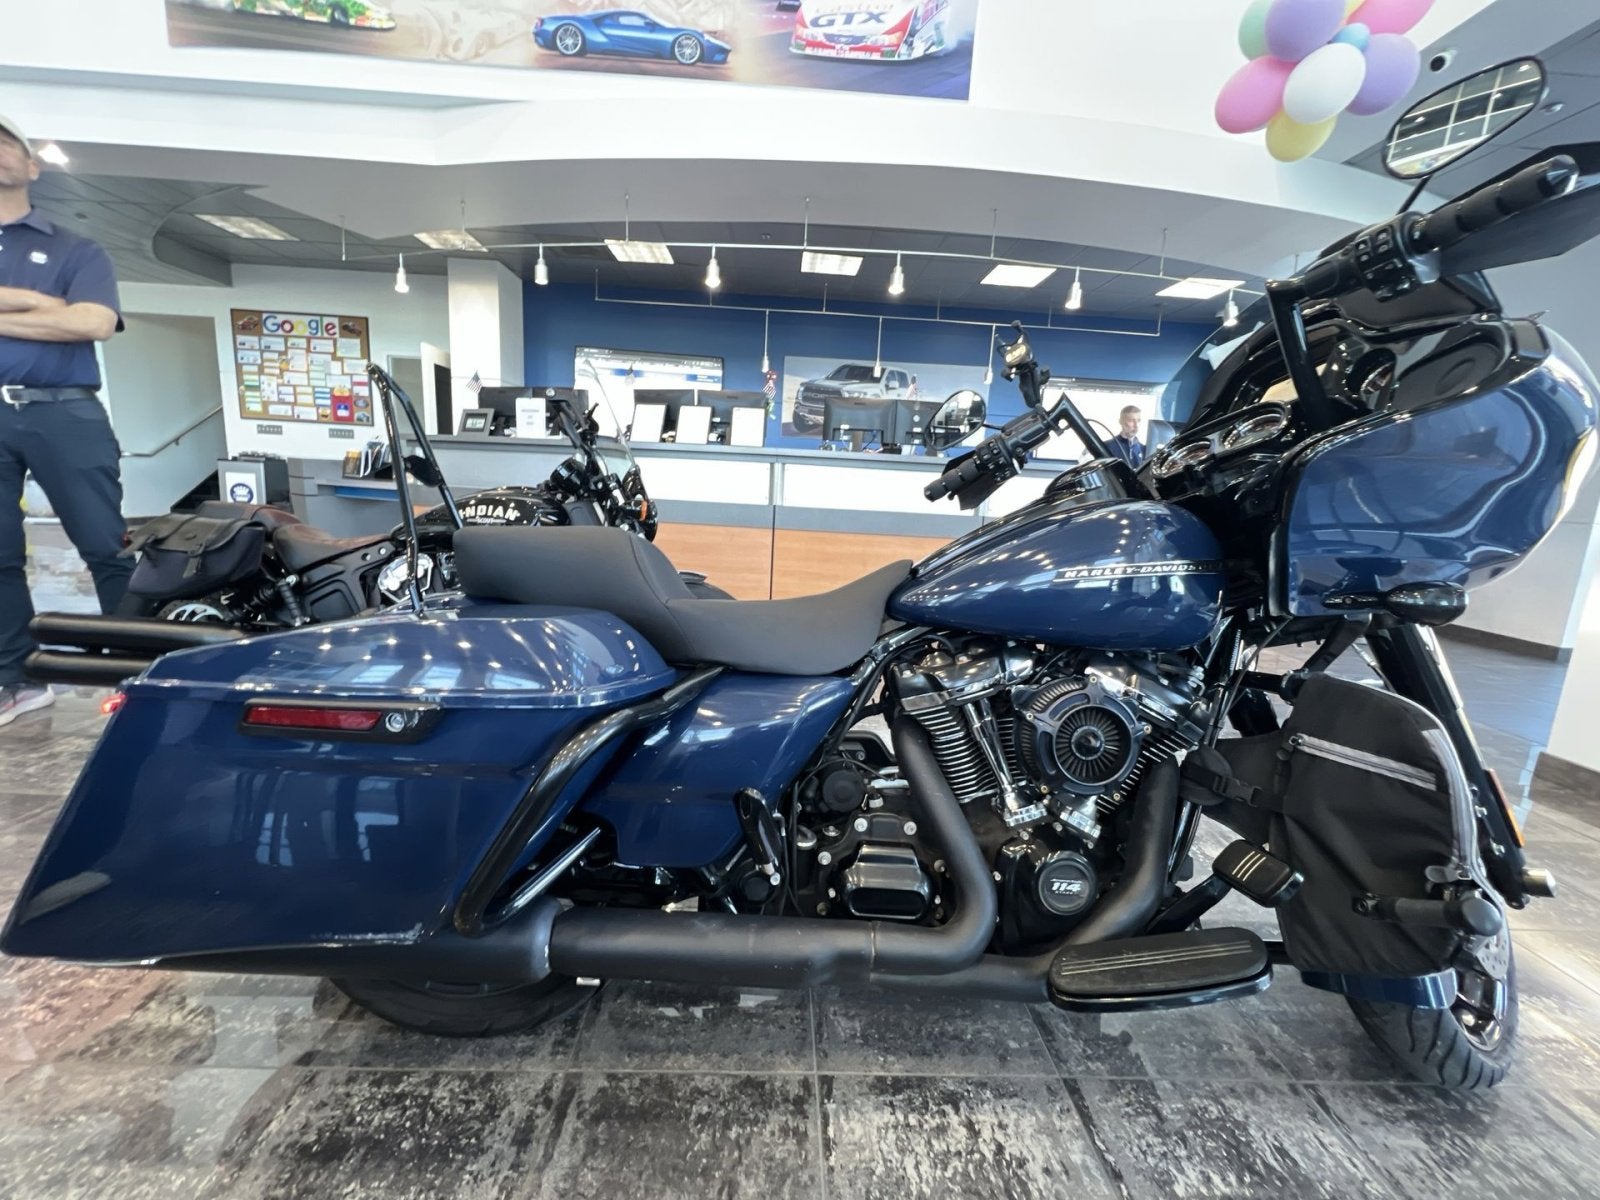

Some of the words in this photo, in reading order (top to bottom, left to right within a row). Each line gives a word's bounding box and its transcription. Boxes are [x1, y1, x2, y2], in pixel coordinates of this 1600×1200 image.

[809, 11, 889, 28] GTX
[263, 315, 337, 336] Google
[1063, 562, 1213, 578] HARLEY-DAVIDS
[1051, 882, 1081, 892] 114
